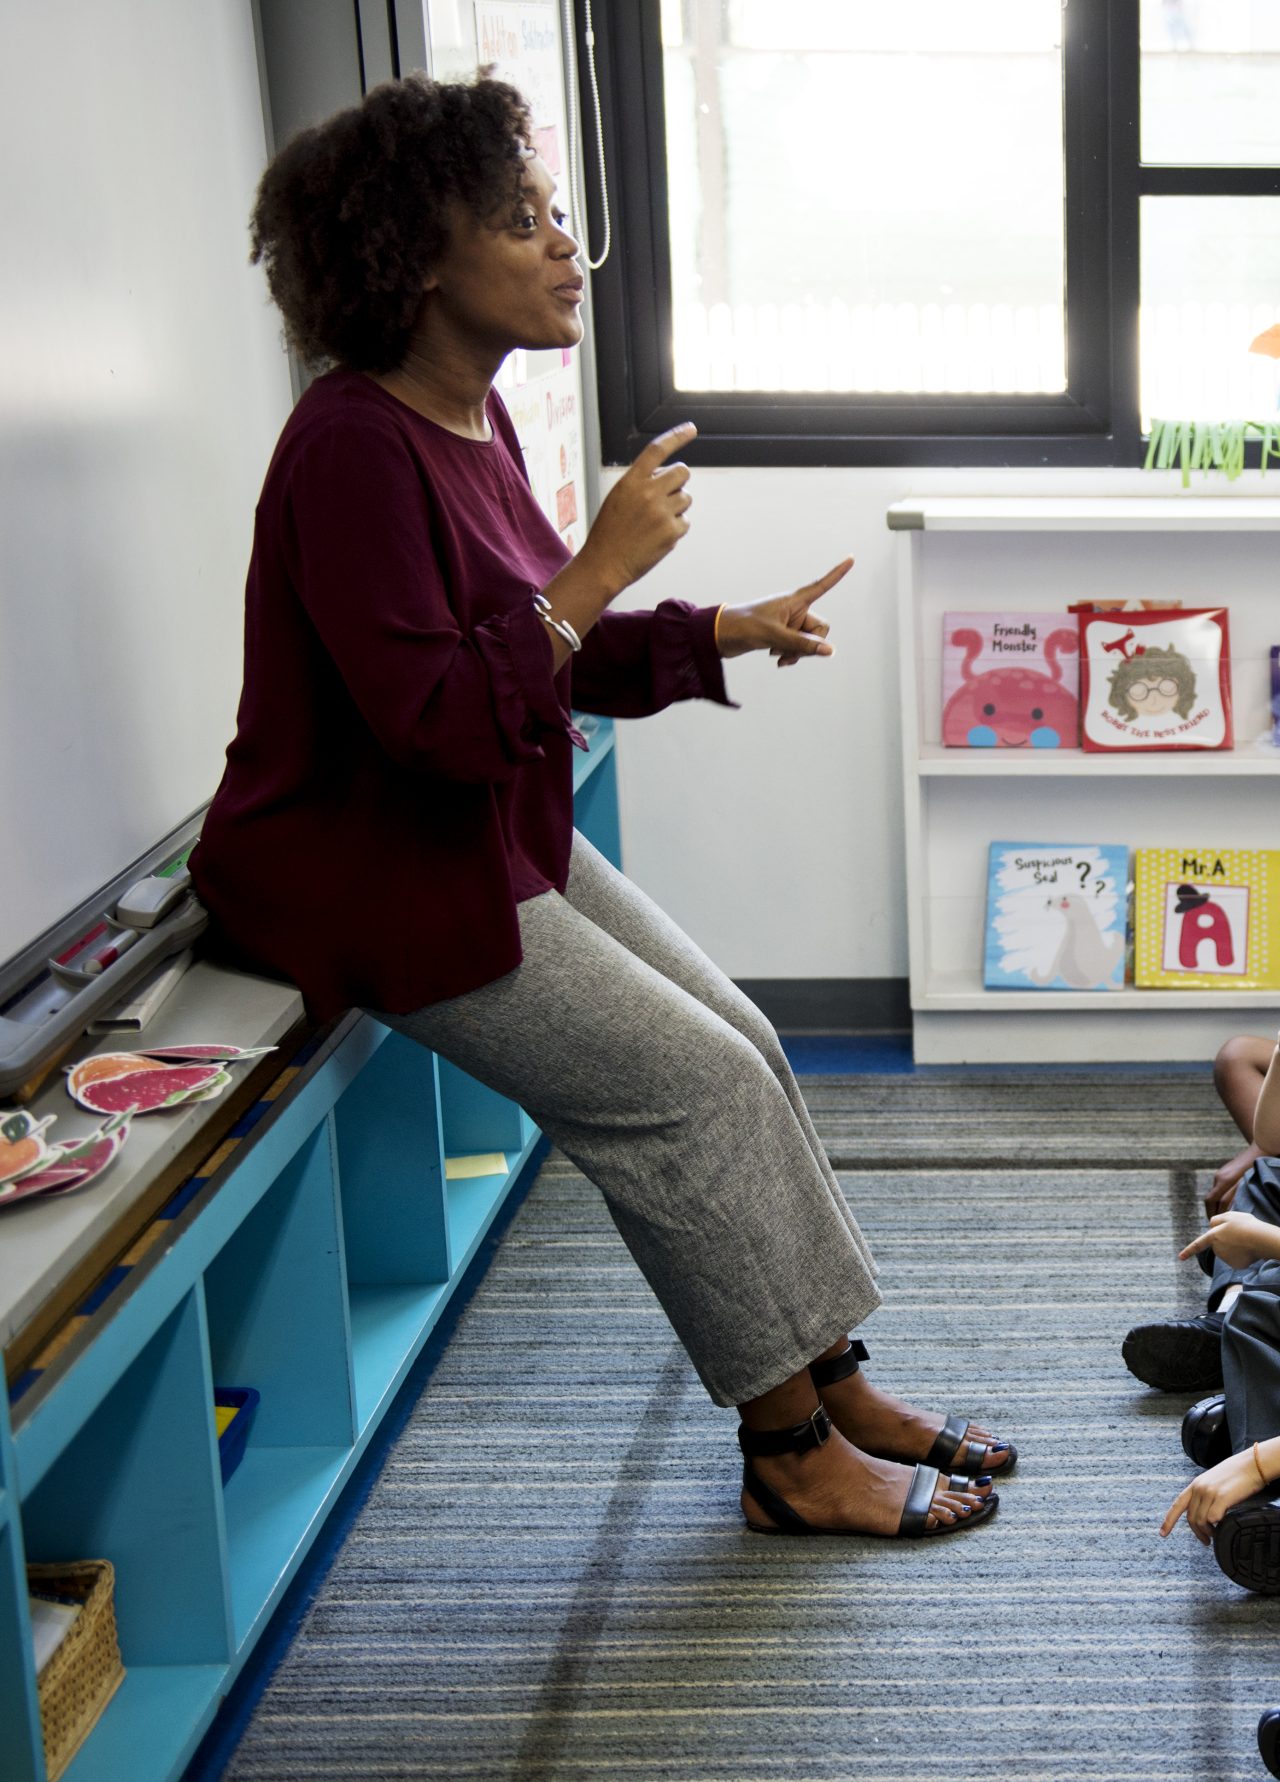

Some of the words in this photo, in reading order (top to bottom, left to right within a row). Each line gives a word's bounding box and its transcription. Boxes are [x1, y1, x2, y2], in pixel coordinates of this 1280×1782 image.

[993, 624, 1037, 640] Friendly
[992, 640, 1037, 653] Monster
[1015, 857, 1073, 872] Suspicious
[1182, 859, 1225, 876] Mr.A
[1033, 871, 1058, 885] Seal
